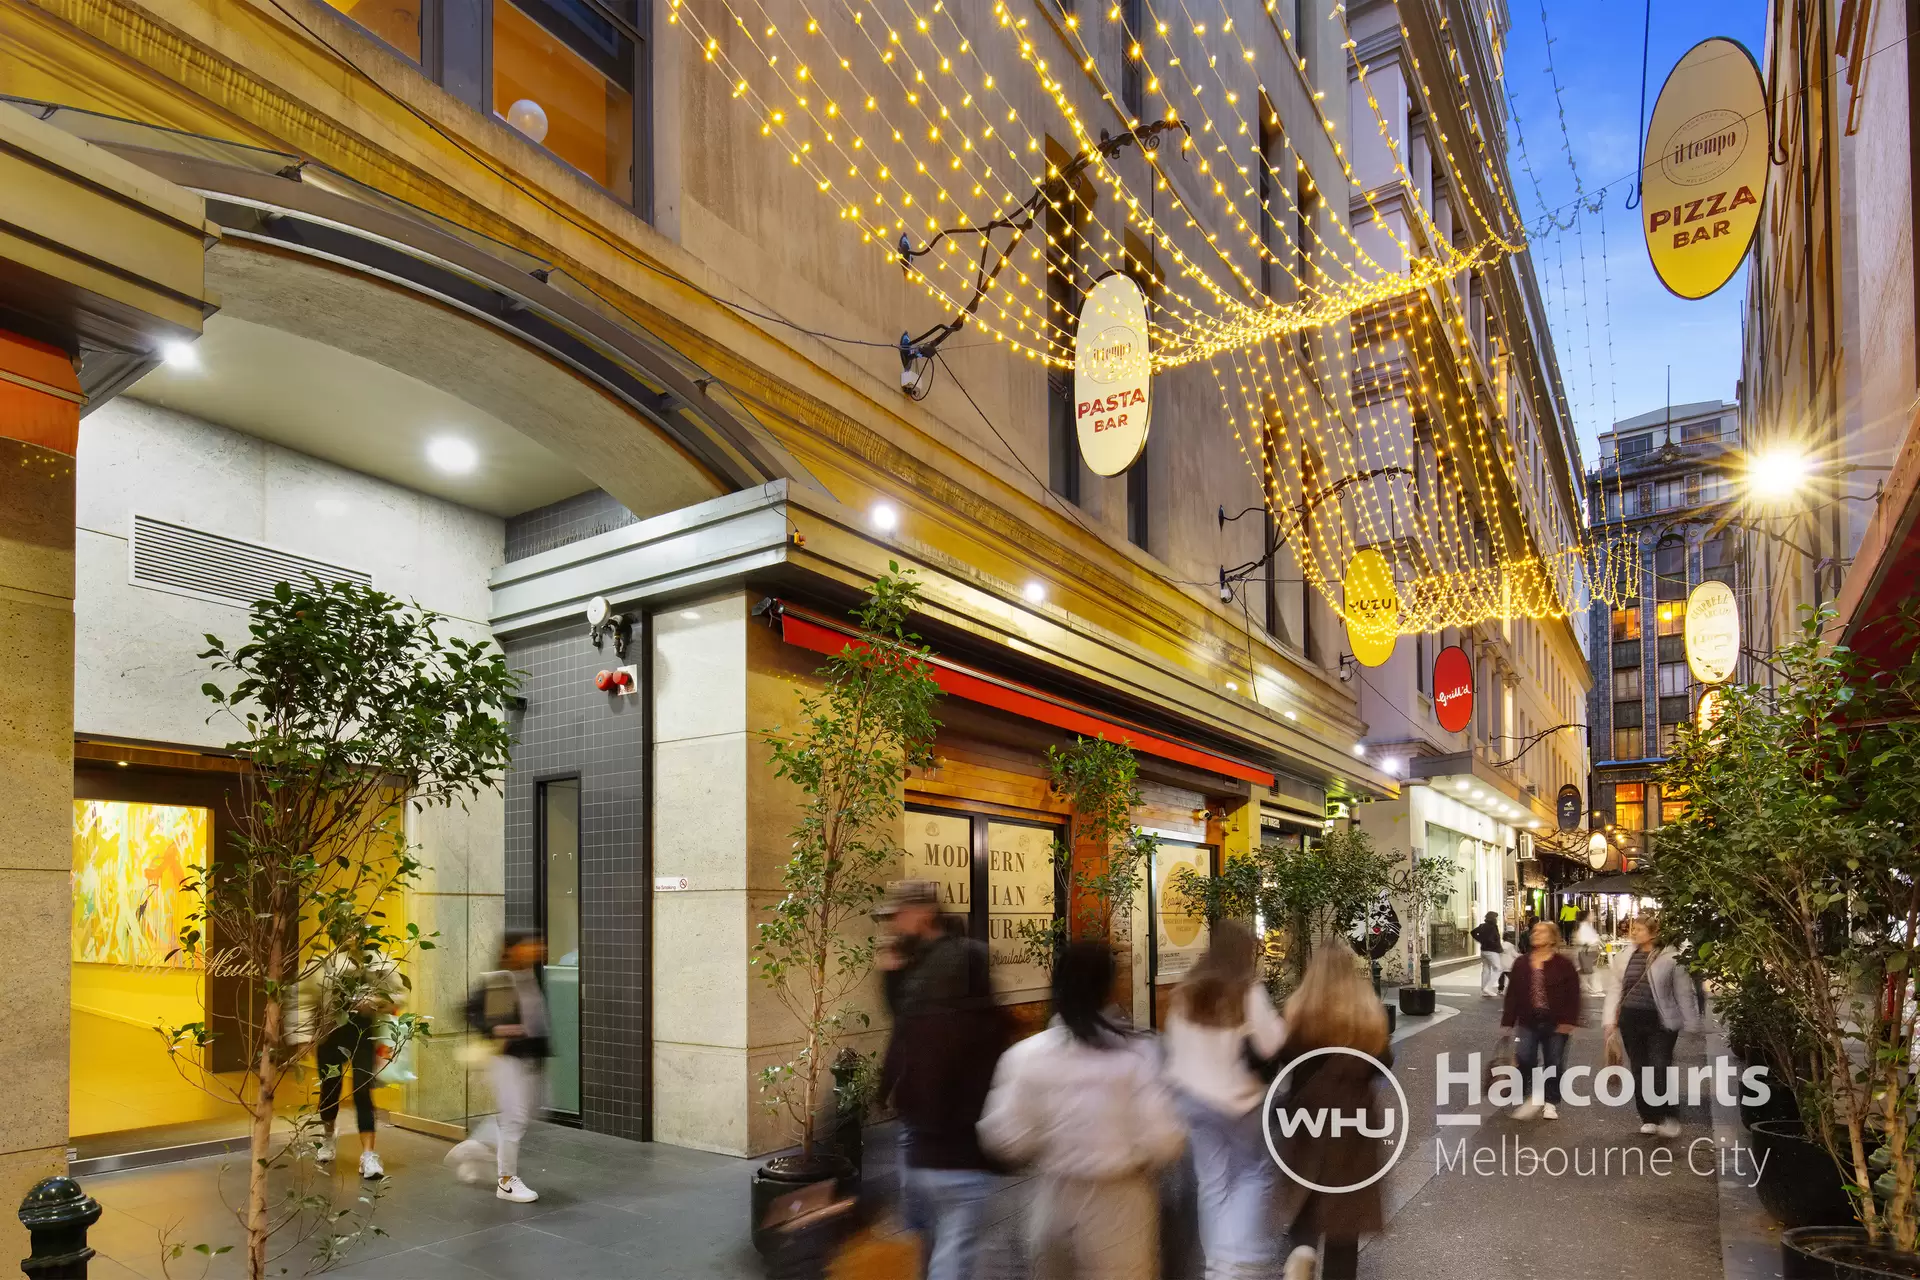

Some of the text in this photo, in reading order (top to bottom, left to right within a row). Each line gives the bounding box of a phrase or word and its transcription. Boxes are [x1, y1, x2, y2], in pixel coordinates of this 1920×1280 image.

[1675, 131, 1736, 164] il tempo
[1650, 185, 1757, 233] PIZZA
[1673, 220, 1731, 249] BAR
[1077, 388, 1146, 419] PASTA
[1094, 414, 1128, 433] BAR
[1349, 598, 1392, 613] YUZU
[1437, 684, 1471, 706] Grill'd
[930, 881, 1026, 906] TALIAN
[990, 947, 1032, 967] Available
